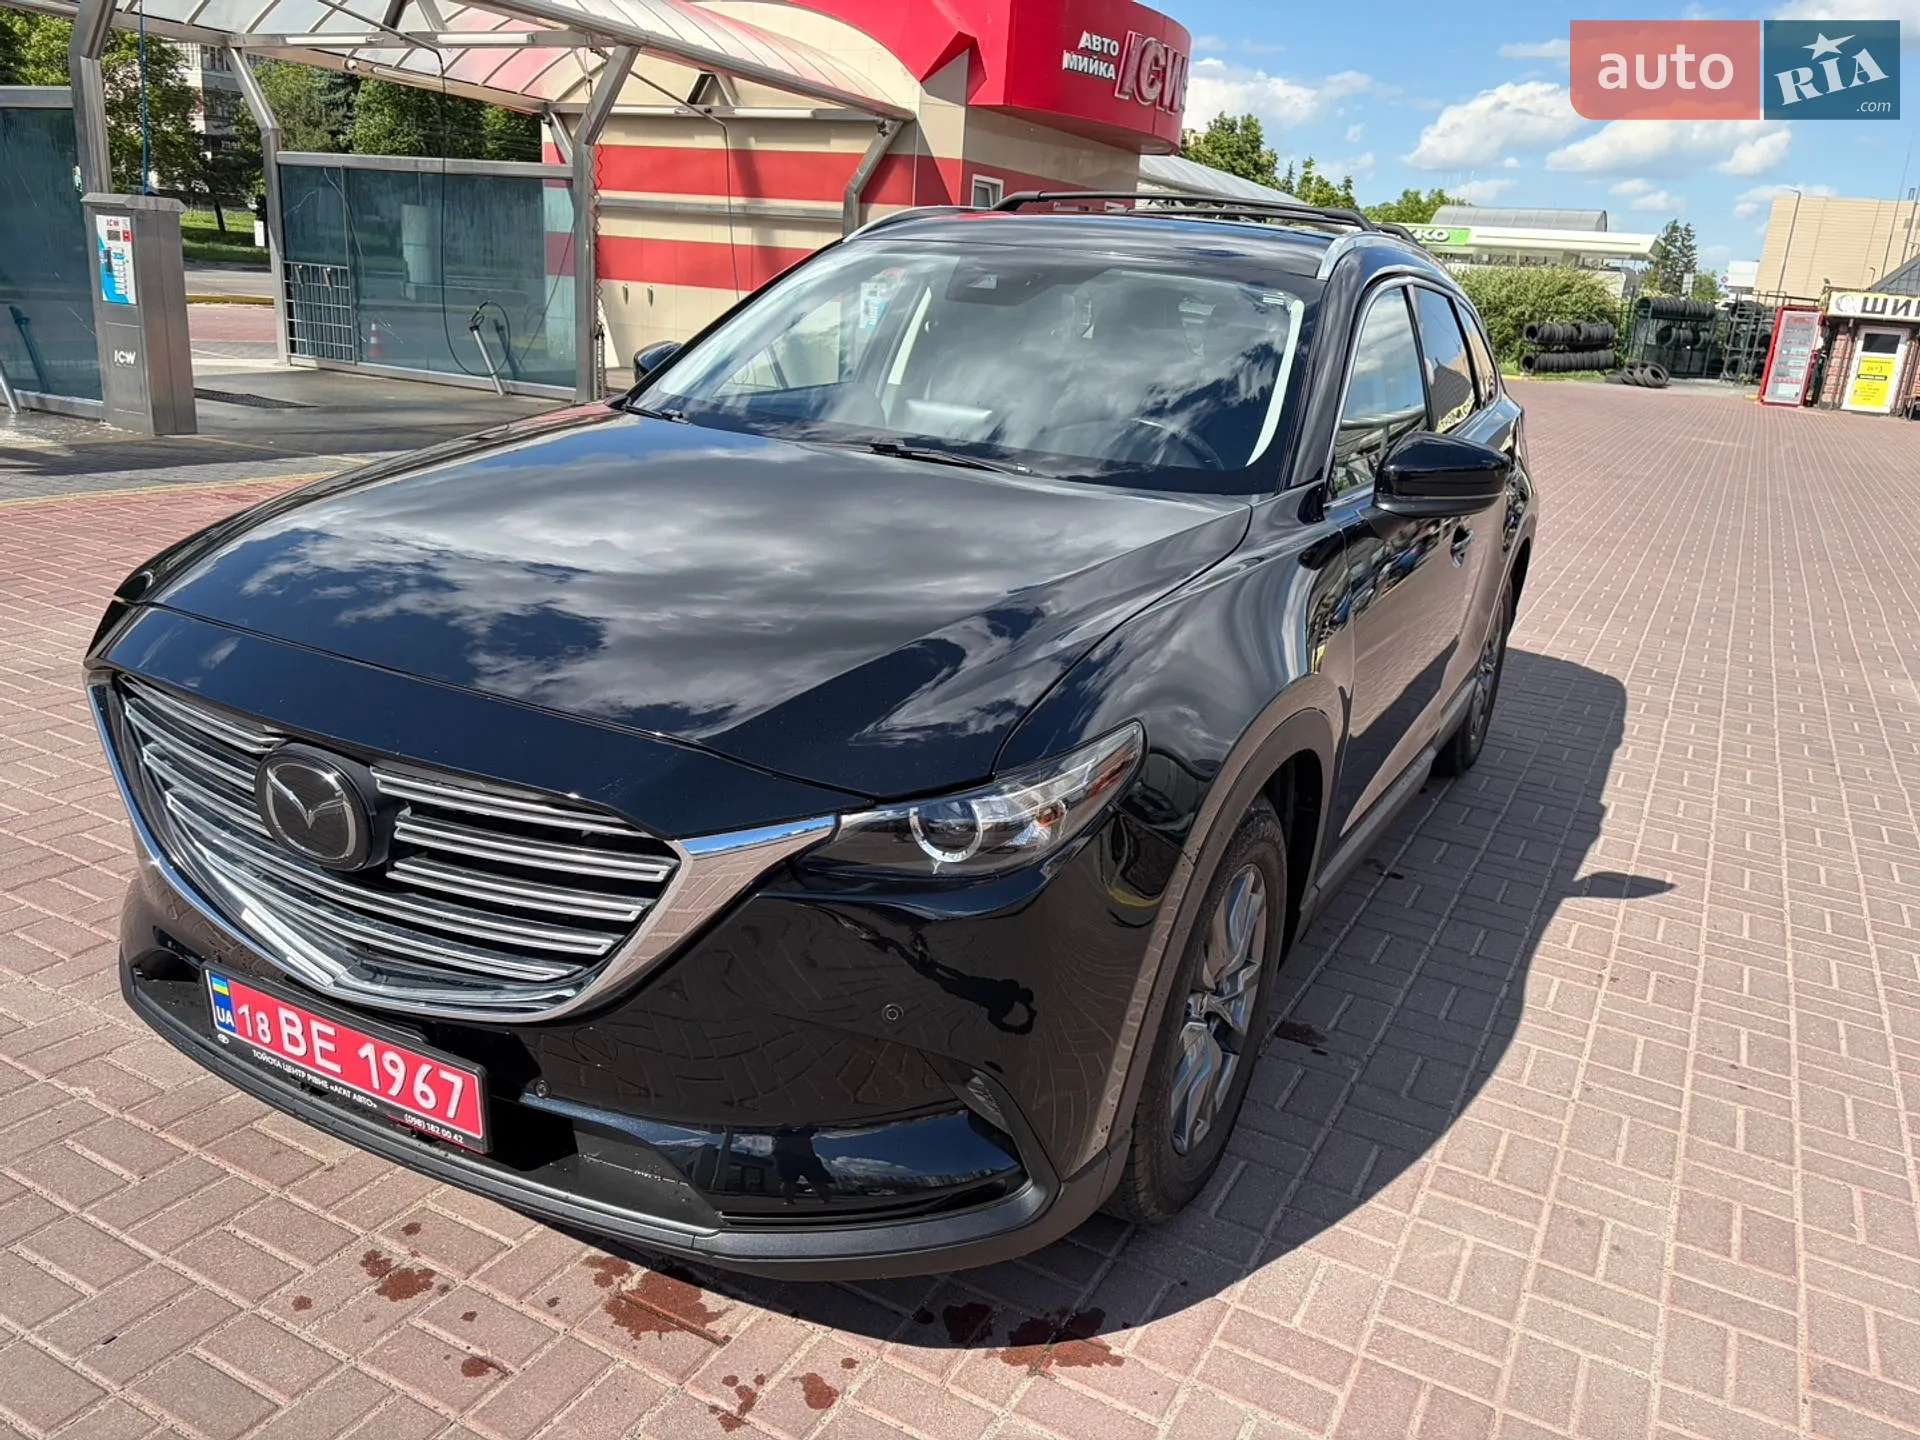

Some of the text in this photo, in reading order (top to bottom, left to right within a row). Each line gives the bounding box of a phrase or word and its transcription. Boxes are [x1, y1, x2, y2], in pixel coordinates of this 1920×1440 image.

[1078, 30, 1120, 57] АВТО
[1062, 50, 1116, 80] МИЙКА
[114, 350, 136, 365] ICW
[215, 1005, 235, 1028] UA
[237, 1004, 465, 1119] 18 BE 1967
